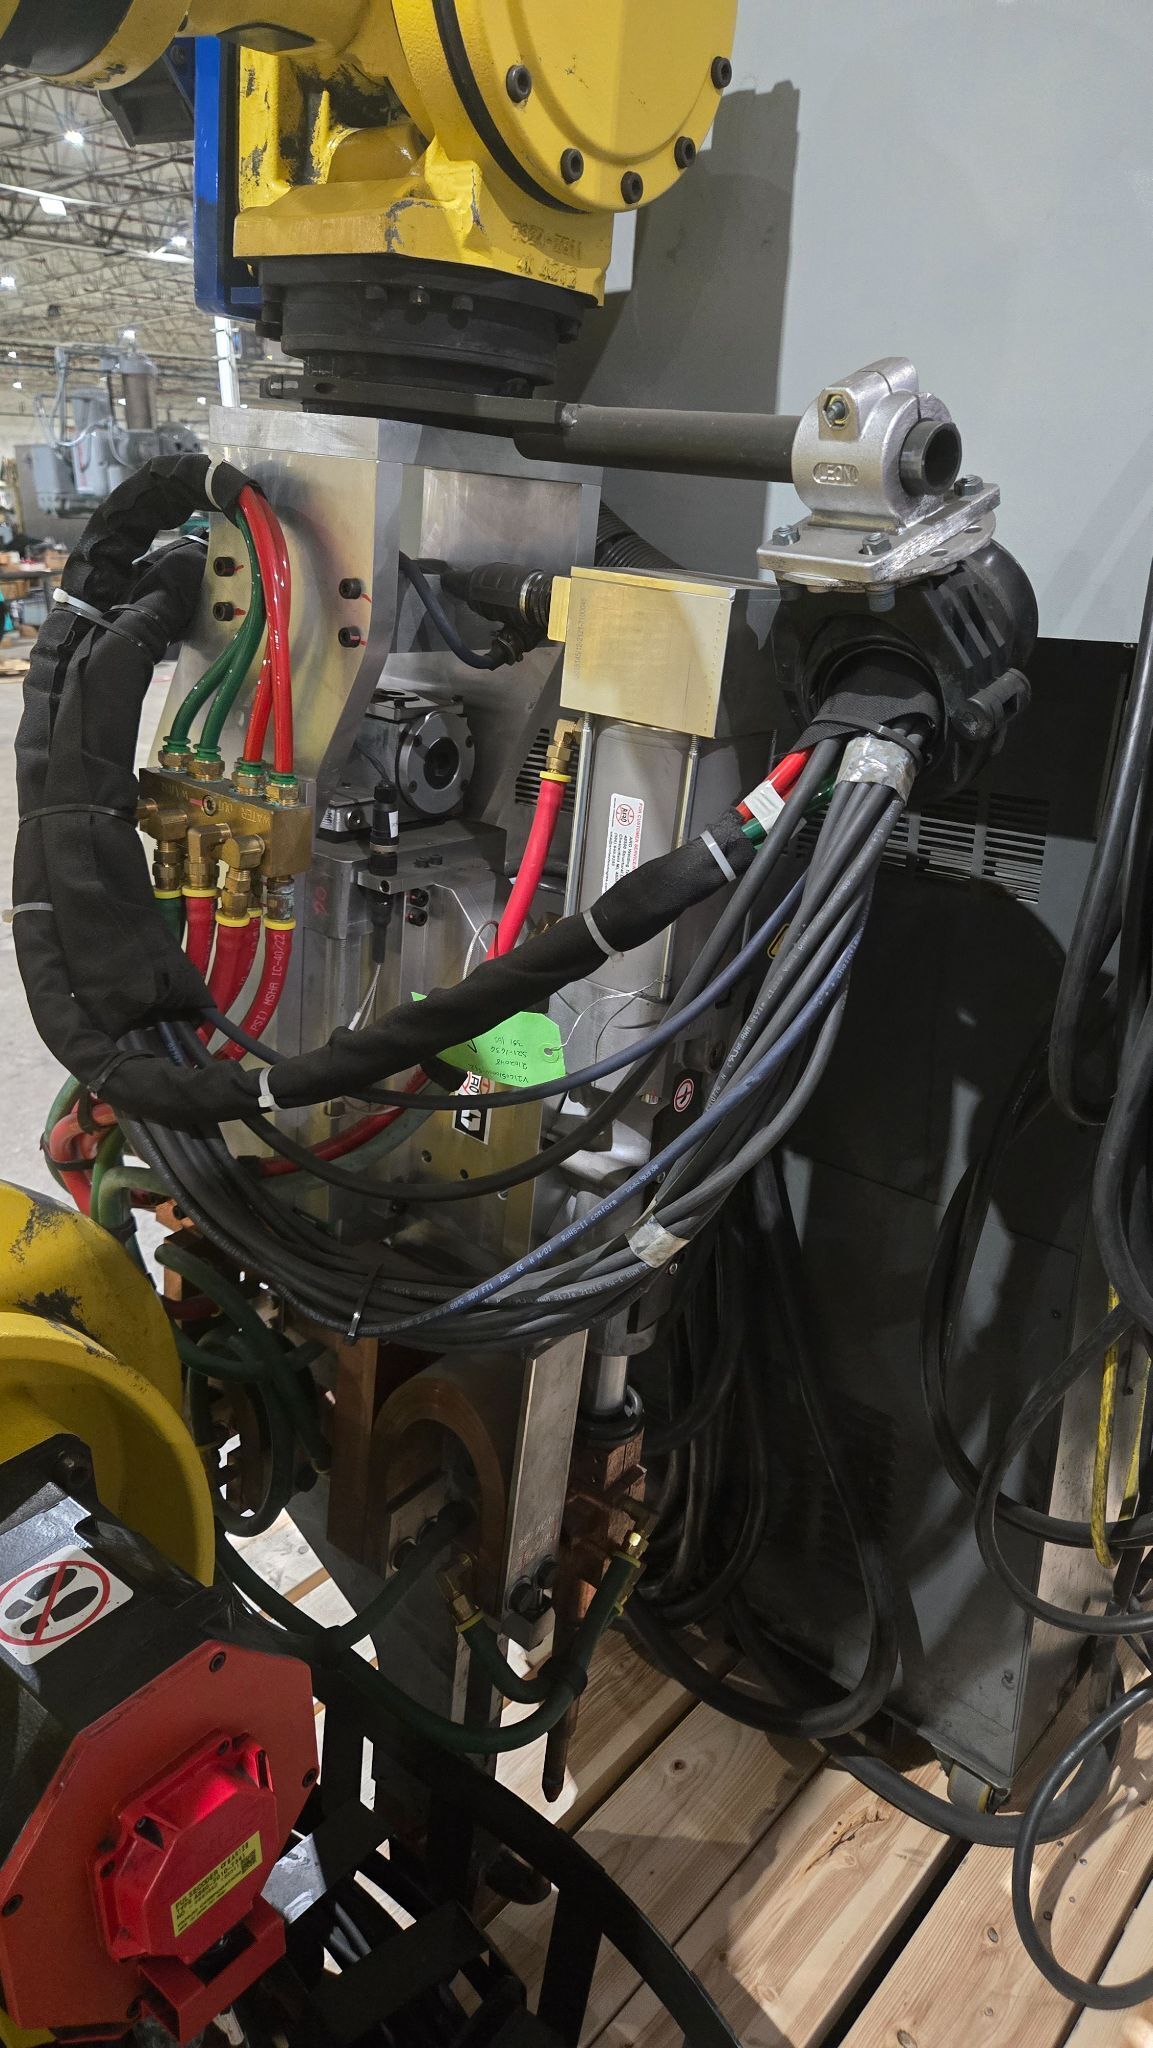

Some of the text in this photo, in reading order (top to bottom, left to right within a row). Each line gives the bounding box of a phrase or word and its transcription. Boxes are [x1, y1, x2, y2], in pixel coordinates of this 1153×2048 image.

[216, 799, 272, 826] WATER OUT
[634, 814, 642, 843] CUSTOMER
[271, 934, 286, 976] IC-40/22
[263, 982, 279, 1006] MSHA
[250, 1010, 266, 1032] PSI)
[479, 1281, 494, 1293] FT1
[589, 1198, 618, 1222] conform
